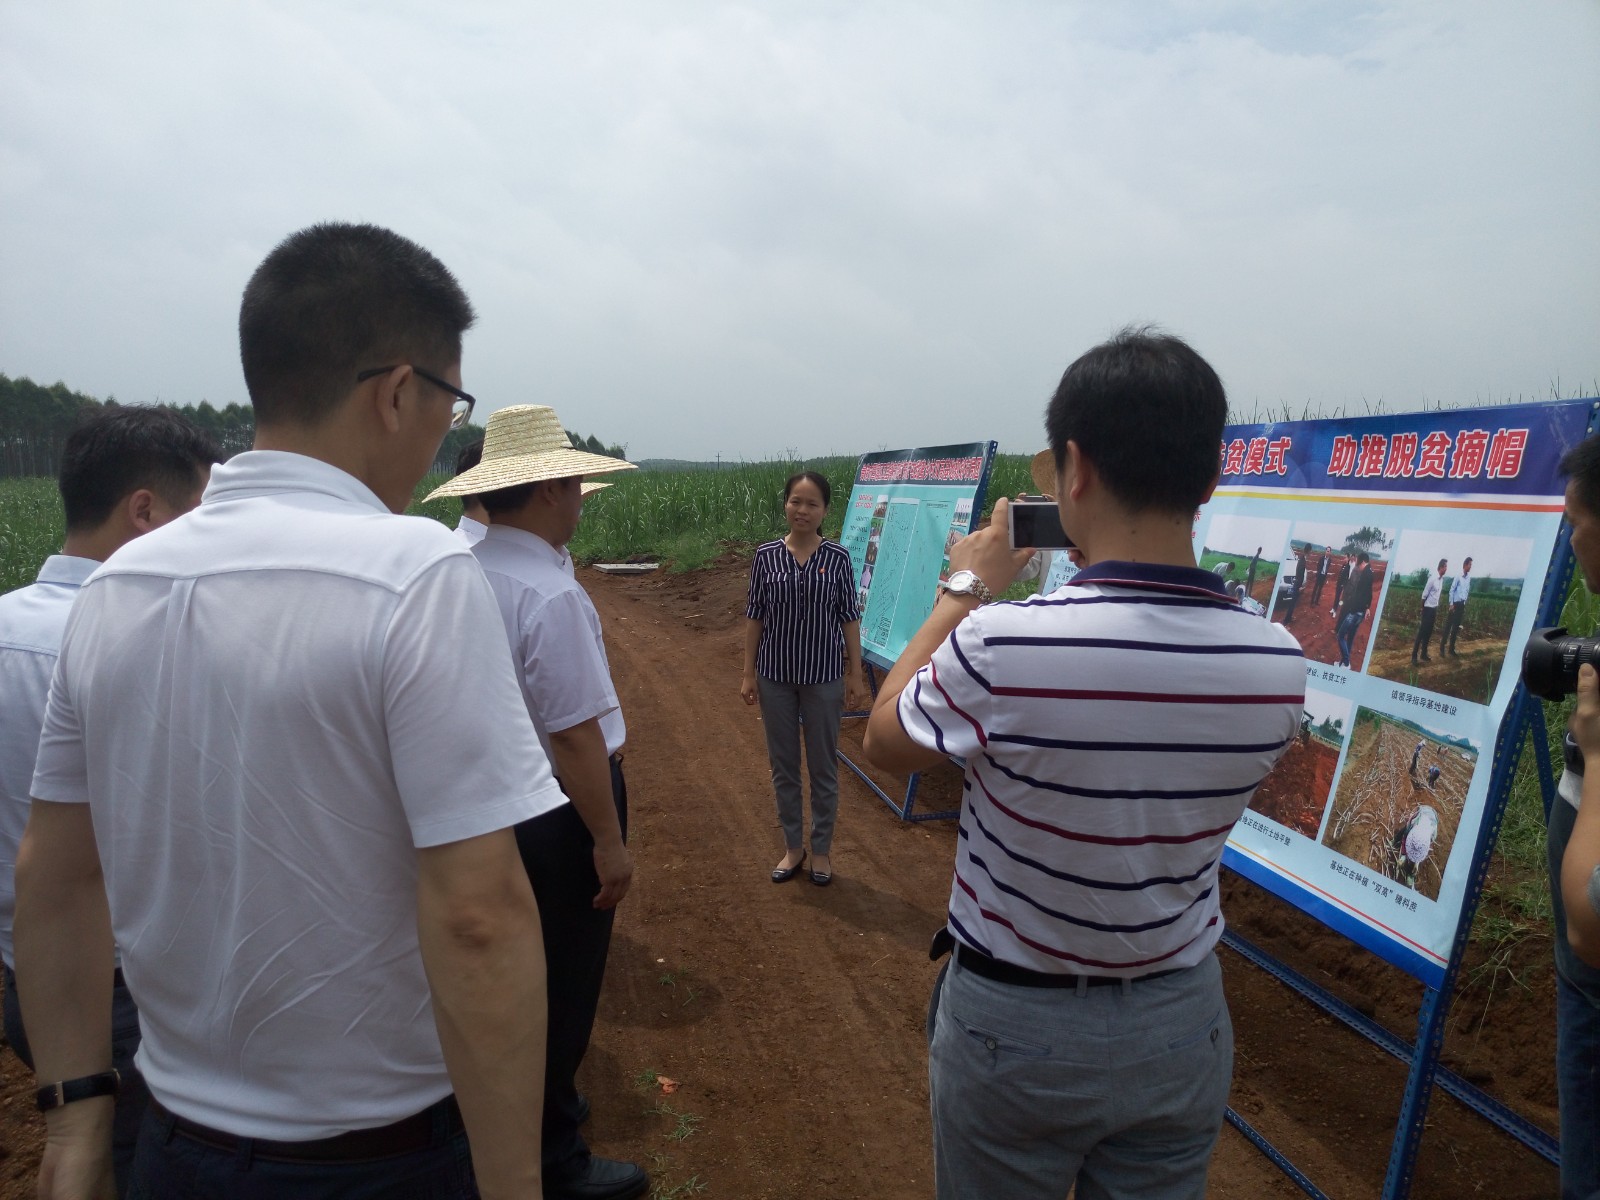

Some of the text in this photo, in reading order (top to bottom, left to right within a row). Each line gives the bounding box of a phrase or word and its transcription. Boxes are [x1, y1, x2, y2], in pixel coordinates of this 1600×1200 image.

[1327, 428, 1529, 479] 助推脱贫摘帽
[1391, 690, 1458, 716] 镇领导指导基地建设
